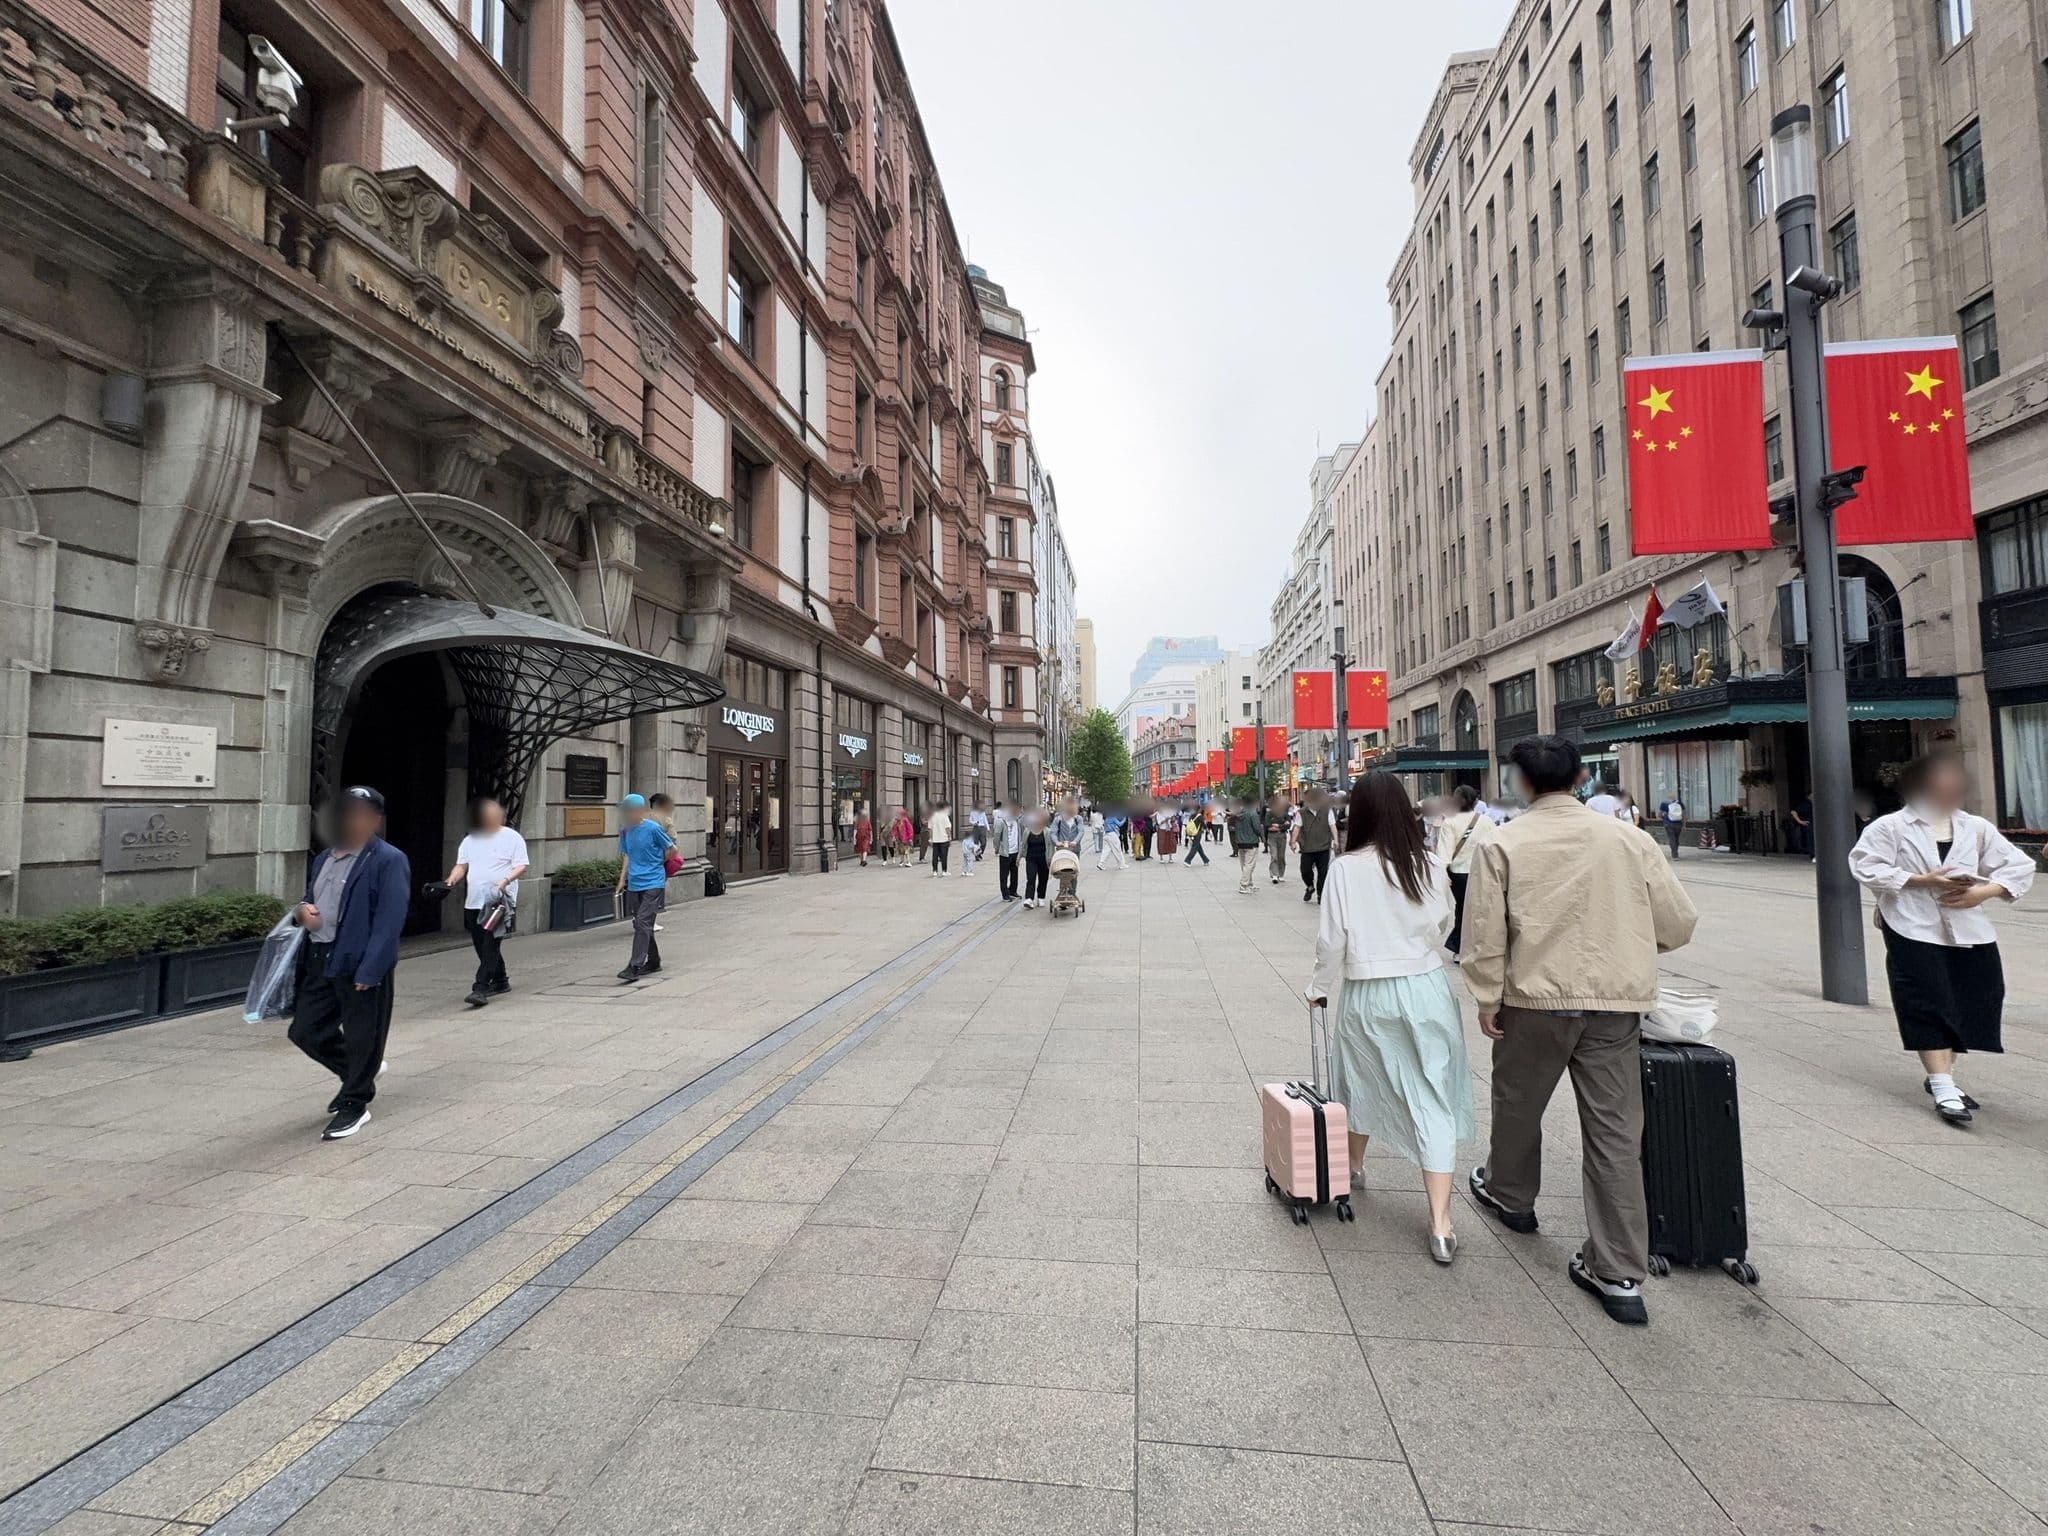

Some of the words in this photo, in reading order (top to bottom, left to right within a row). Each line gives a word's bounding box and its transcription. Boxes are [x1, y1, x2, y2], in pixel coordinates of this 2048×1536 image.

[448, 251, 511, 322] 1906
[350, 272, 391, 306] THE
[397, 302, 465, 353] SWATCH
[473, 354, 502, 380] ART
[506, 376, 548, 411] PEACE
[1615, 704, 1640, 719] PEACE
[1641, 699, 1670, 714] HOTEL
[722, 707, 774, 733] LONGINES
[839, 733, 867, 750] LONGINES
[903, 752, 921, 766] swatch
[120, 831, 191, 846] OMEGA
